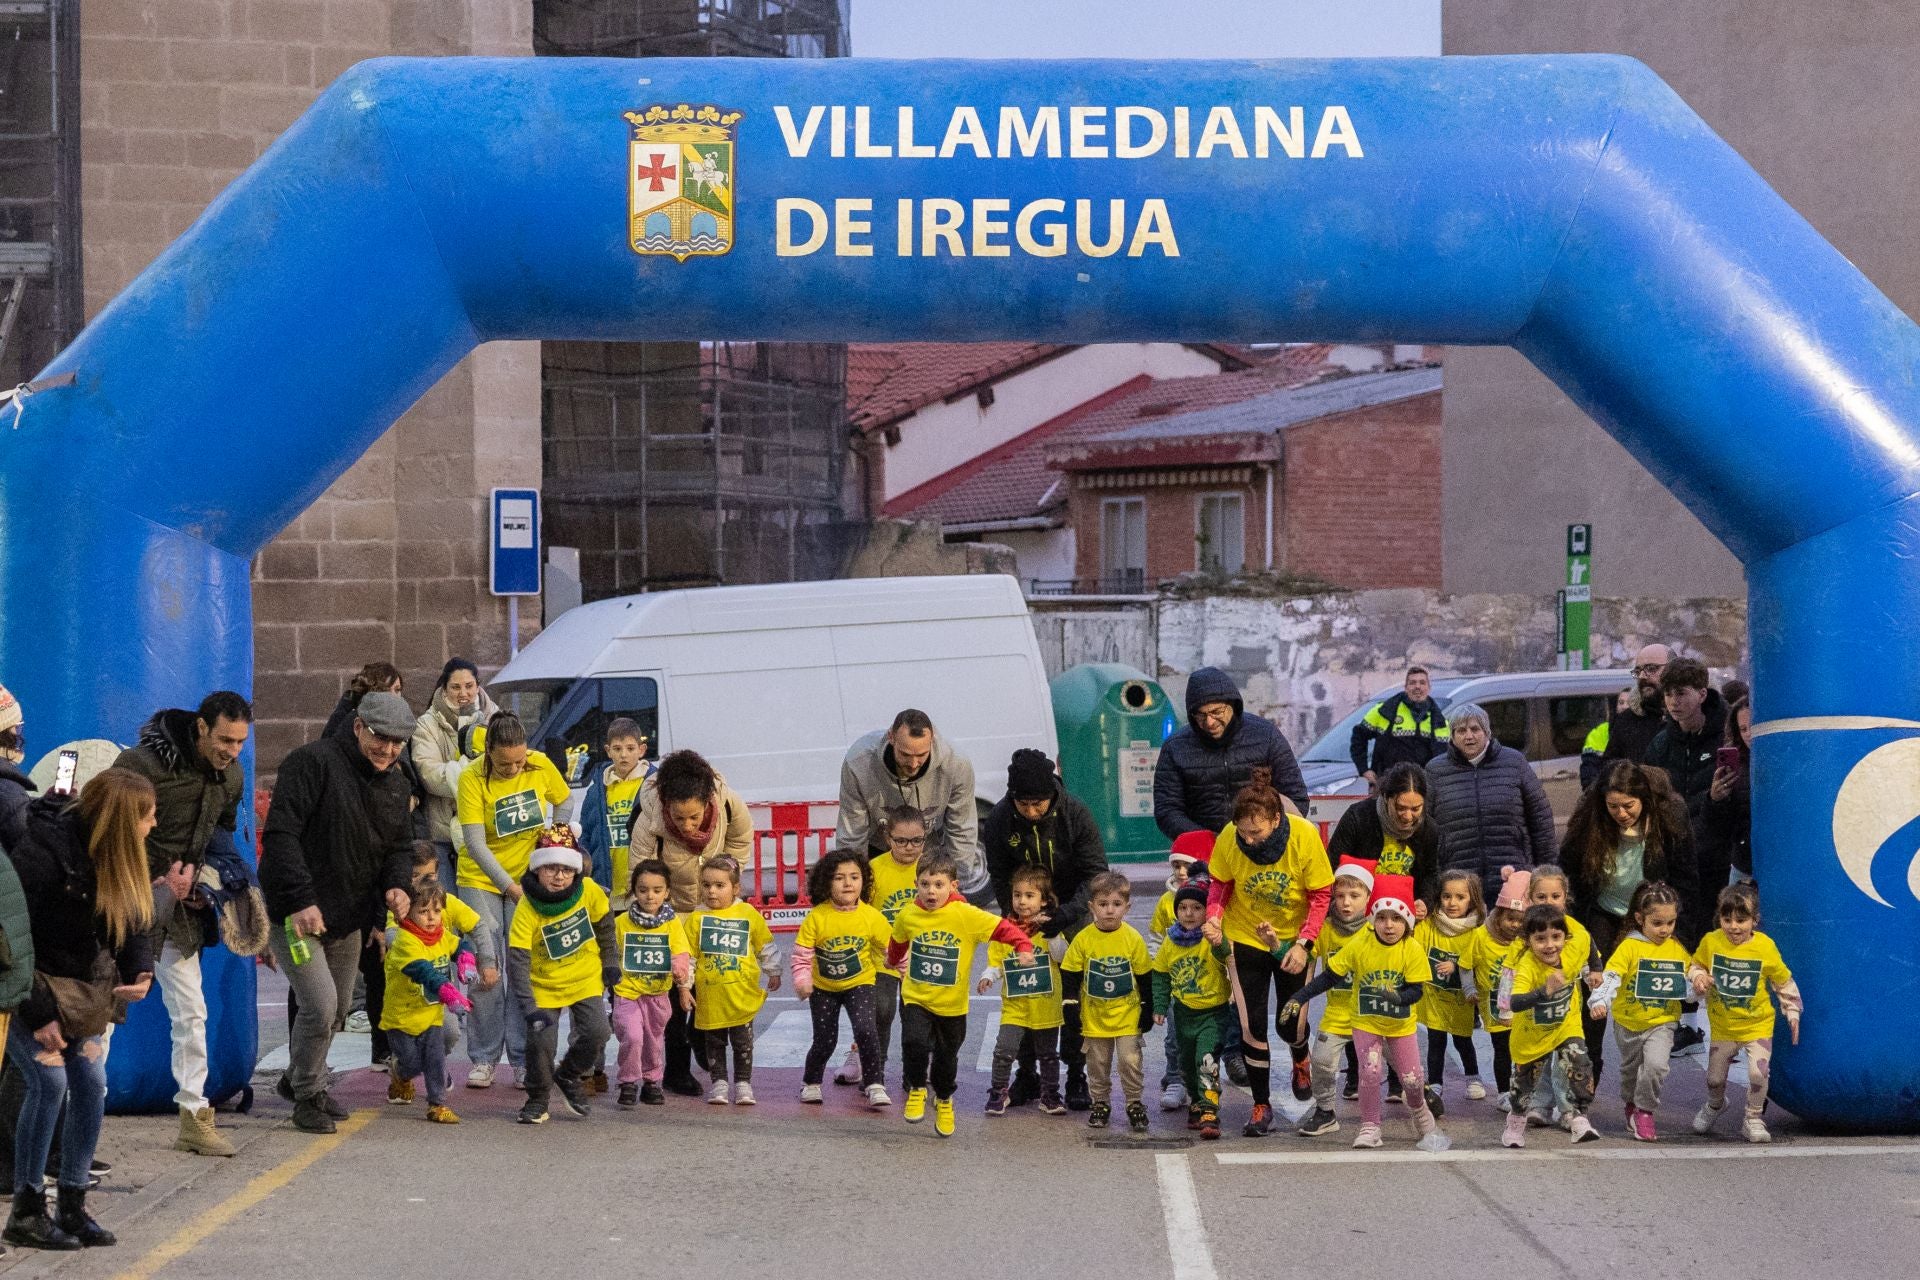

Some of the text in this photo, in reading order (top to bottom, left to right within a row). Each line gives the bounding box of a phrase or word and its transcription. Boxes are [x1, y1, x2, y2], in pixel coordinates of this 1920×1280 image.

[773, 105, 1364, 160] VILLAMEDIANA
[775, 196, 1181, 259] DE IREGUA
[507, 809, 529, 825] 76
[561, 929, 581, 948] 83
[709, 932, 741, 948] 145
[633, 950, 665, 965] 133
[827, 963, 848, 976] 38
[920, 961, 944, 977] 39
[1018, 972, 1038, 988] 44
[1103, 980, 1115, 993] 9
[1650, 977, 1674, 991] 32
[1720, 972, 1752, 990] 124
